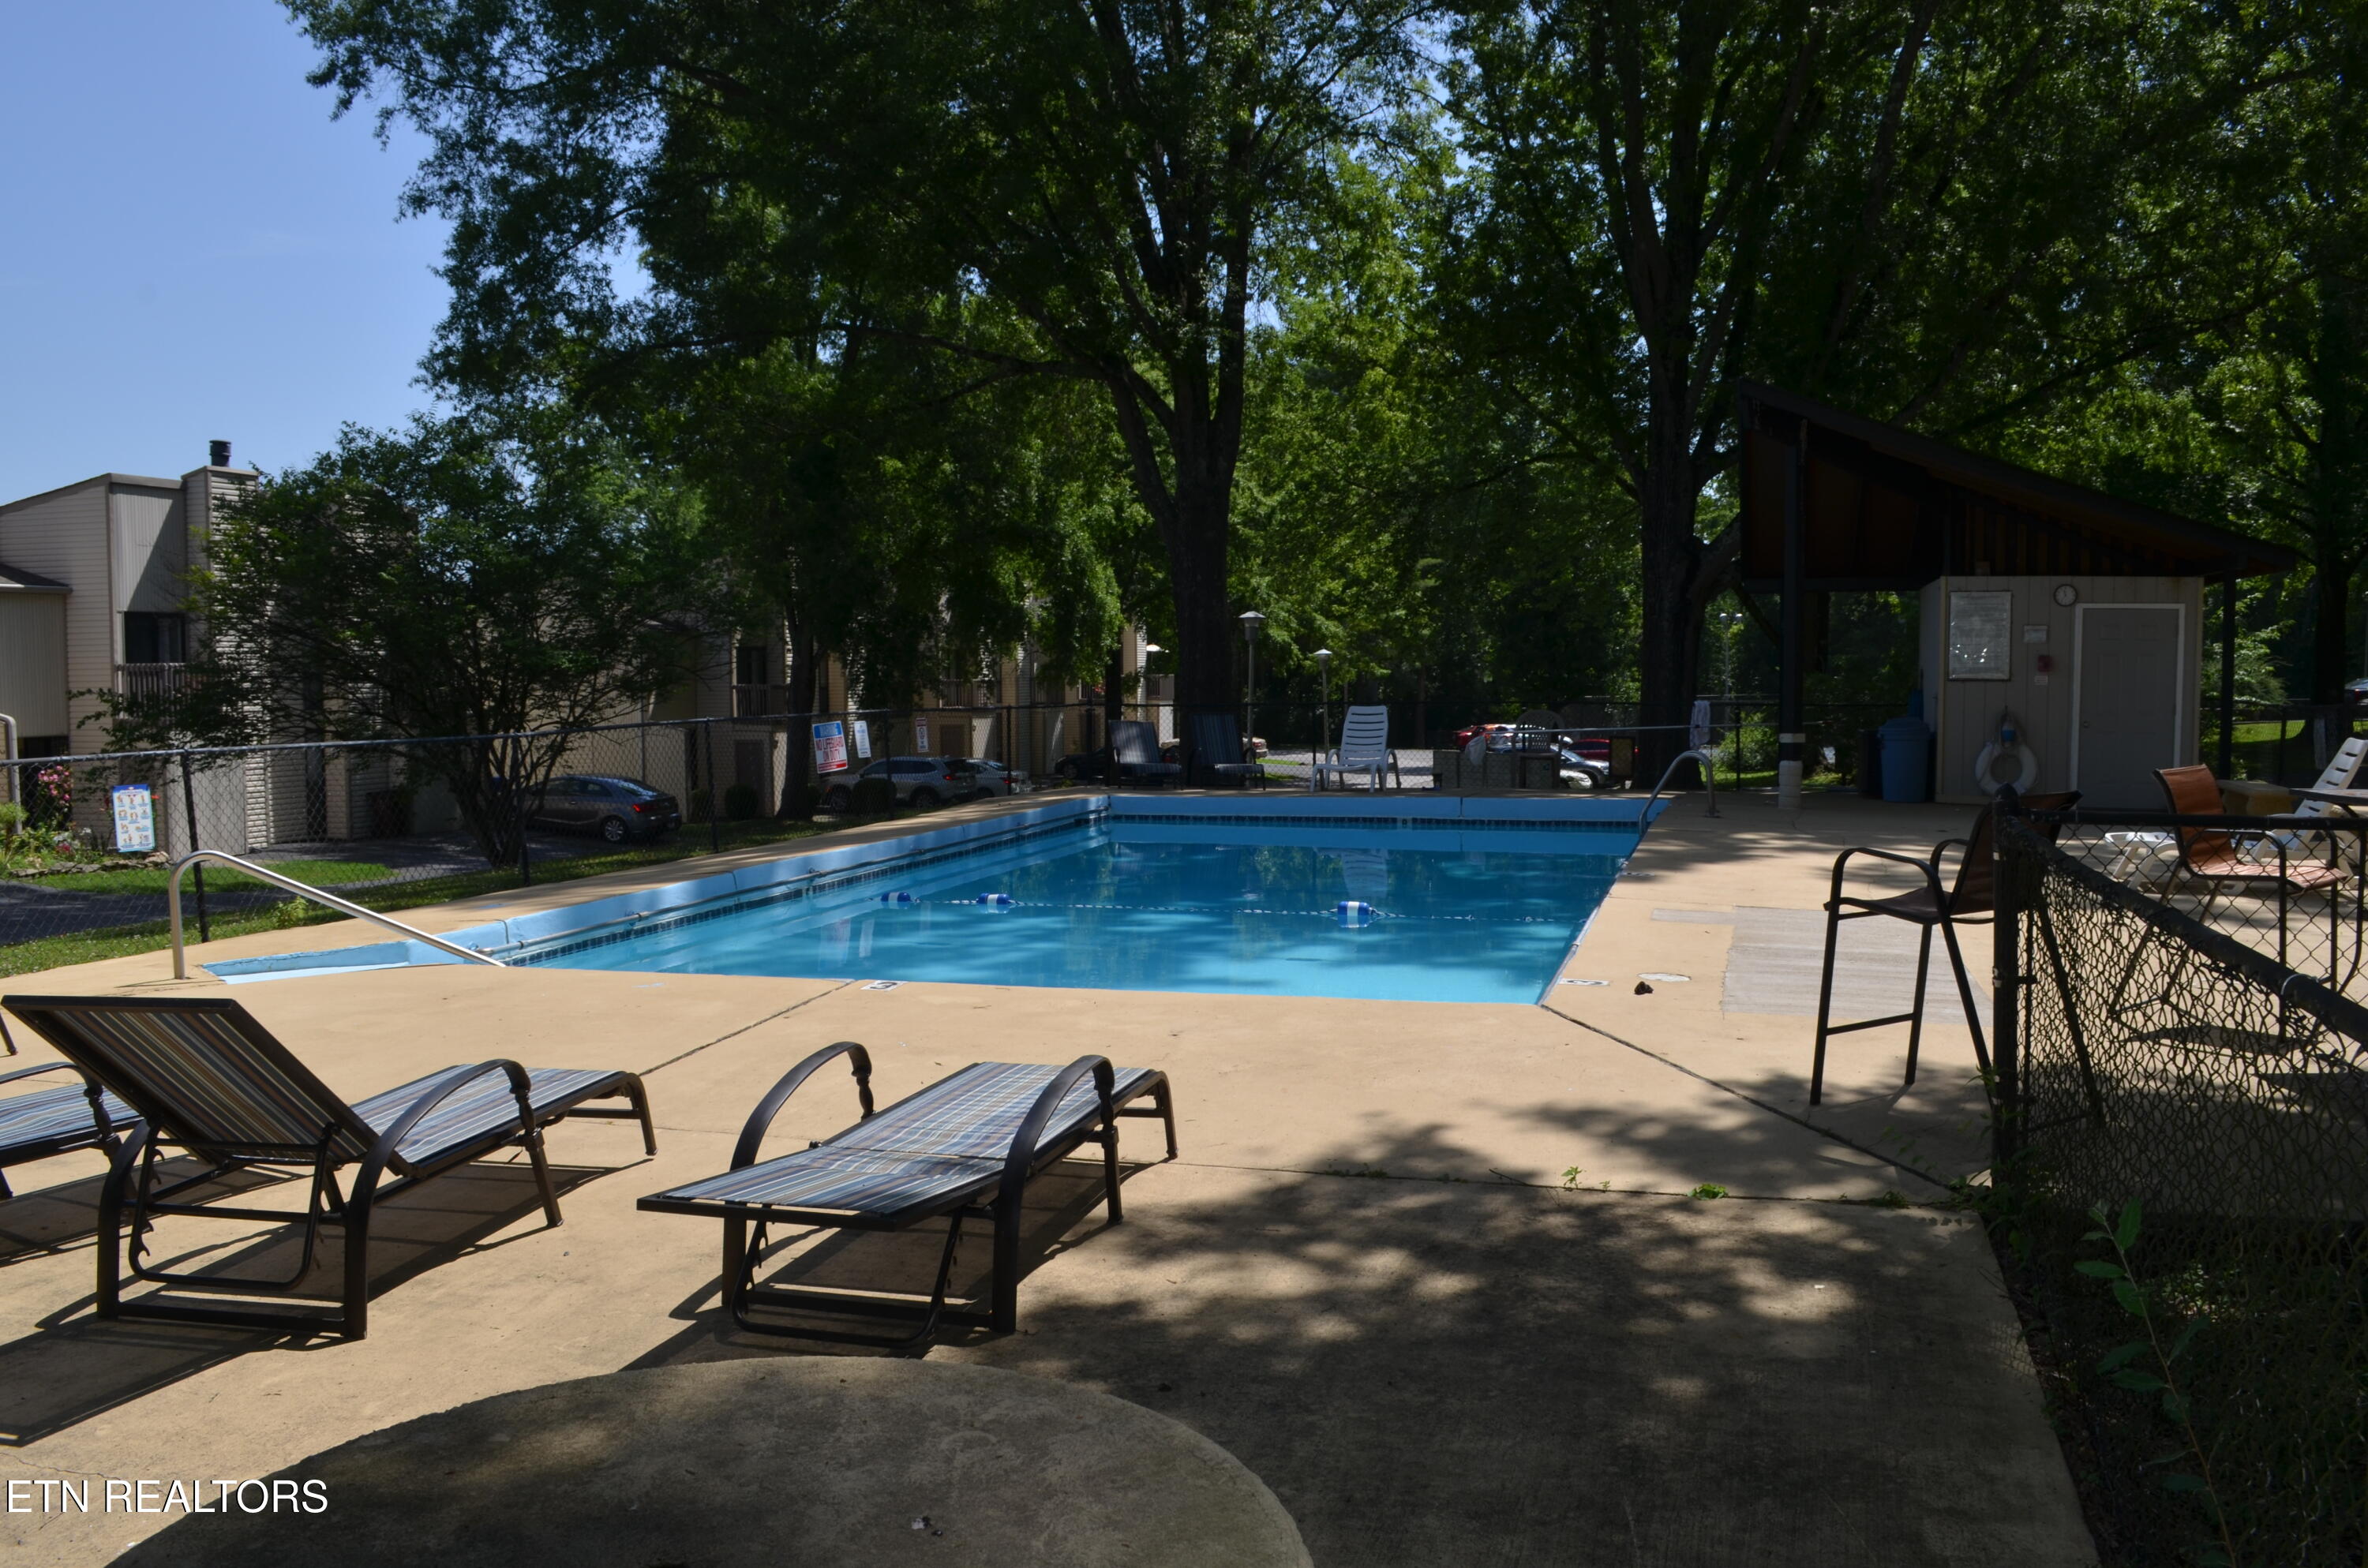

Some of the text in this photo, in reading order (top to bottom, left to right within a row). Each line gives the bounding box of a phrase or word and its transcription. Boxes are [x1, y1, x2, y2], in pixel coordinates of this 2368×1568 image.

[823, 736, 844, 750] LIFEGUARD
[830, 749, 840, 761] DUTY
[870, 981, 897, 990] 3
